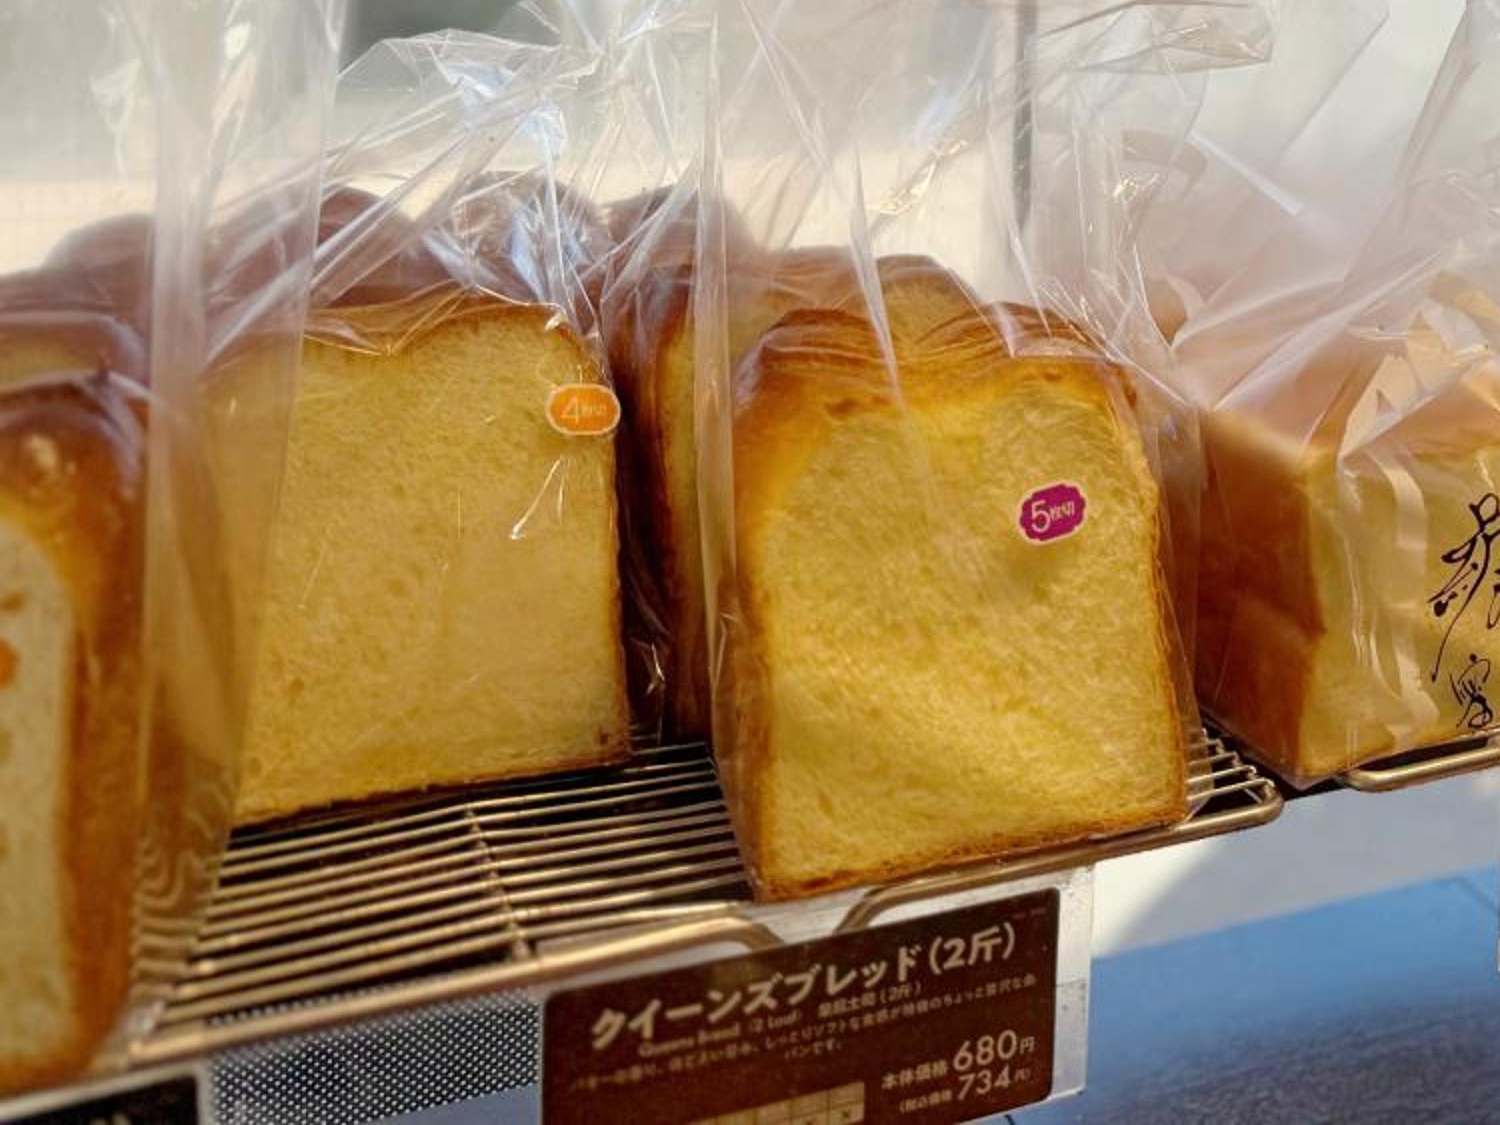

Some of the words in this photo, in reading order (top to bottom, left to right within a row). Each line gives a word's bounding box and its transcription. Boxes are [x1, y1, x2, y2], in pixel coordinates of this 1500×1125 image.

[591, 920, 1016, 1051] クイーンズブレッド(2斤)
[952, 1028, 1036, 1071] 680円
